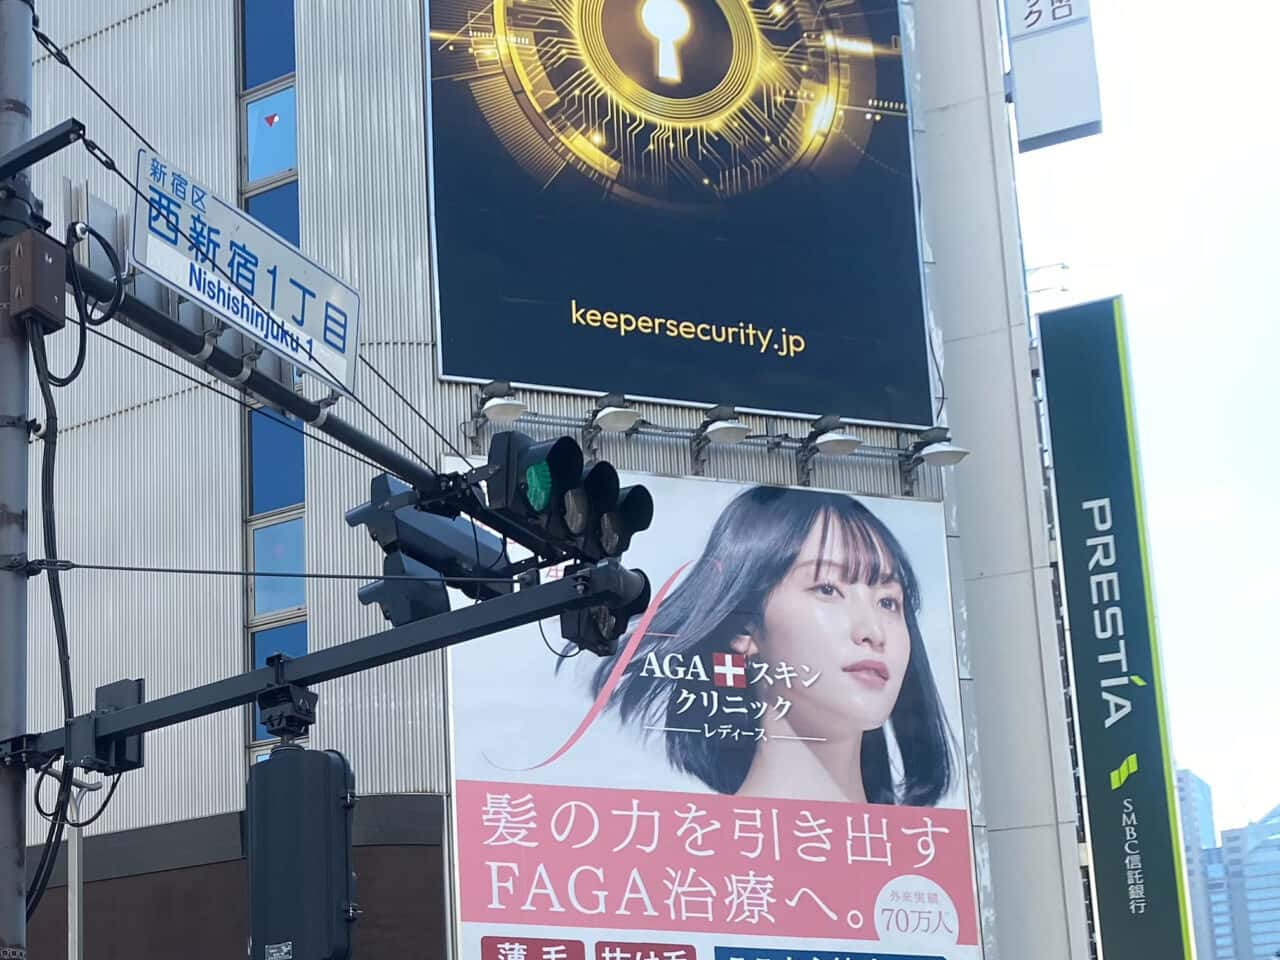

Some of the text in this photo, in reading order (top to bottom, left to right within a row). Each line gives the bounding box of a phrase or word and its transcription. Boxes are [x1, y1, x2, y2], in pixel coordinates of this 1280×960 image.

[150, 157, 207, 214] 新宿区
[148, 185, 348, 354] 西新宿1丁目
[189, 262, 299, 353] Nishishinjuku
[571, 300, 806, 356] keepersecurity.jp
[639, 652, 821, 688] AGA スキン
[675, 688, 792, 721] クリニック
[702, 724, 768, 743] レディース
[481, 792, 950, 869] 髪の力を引き出す
[1122, 799, 1146, 914] SMBC信託銀行
[486, 862, 864, 929] FAGA治療へ。
[881, 906, 954, 936] 70万人
